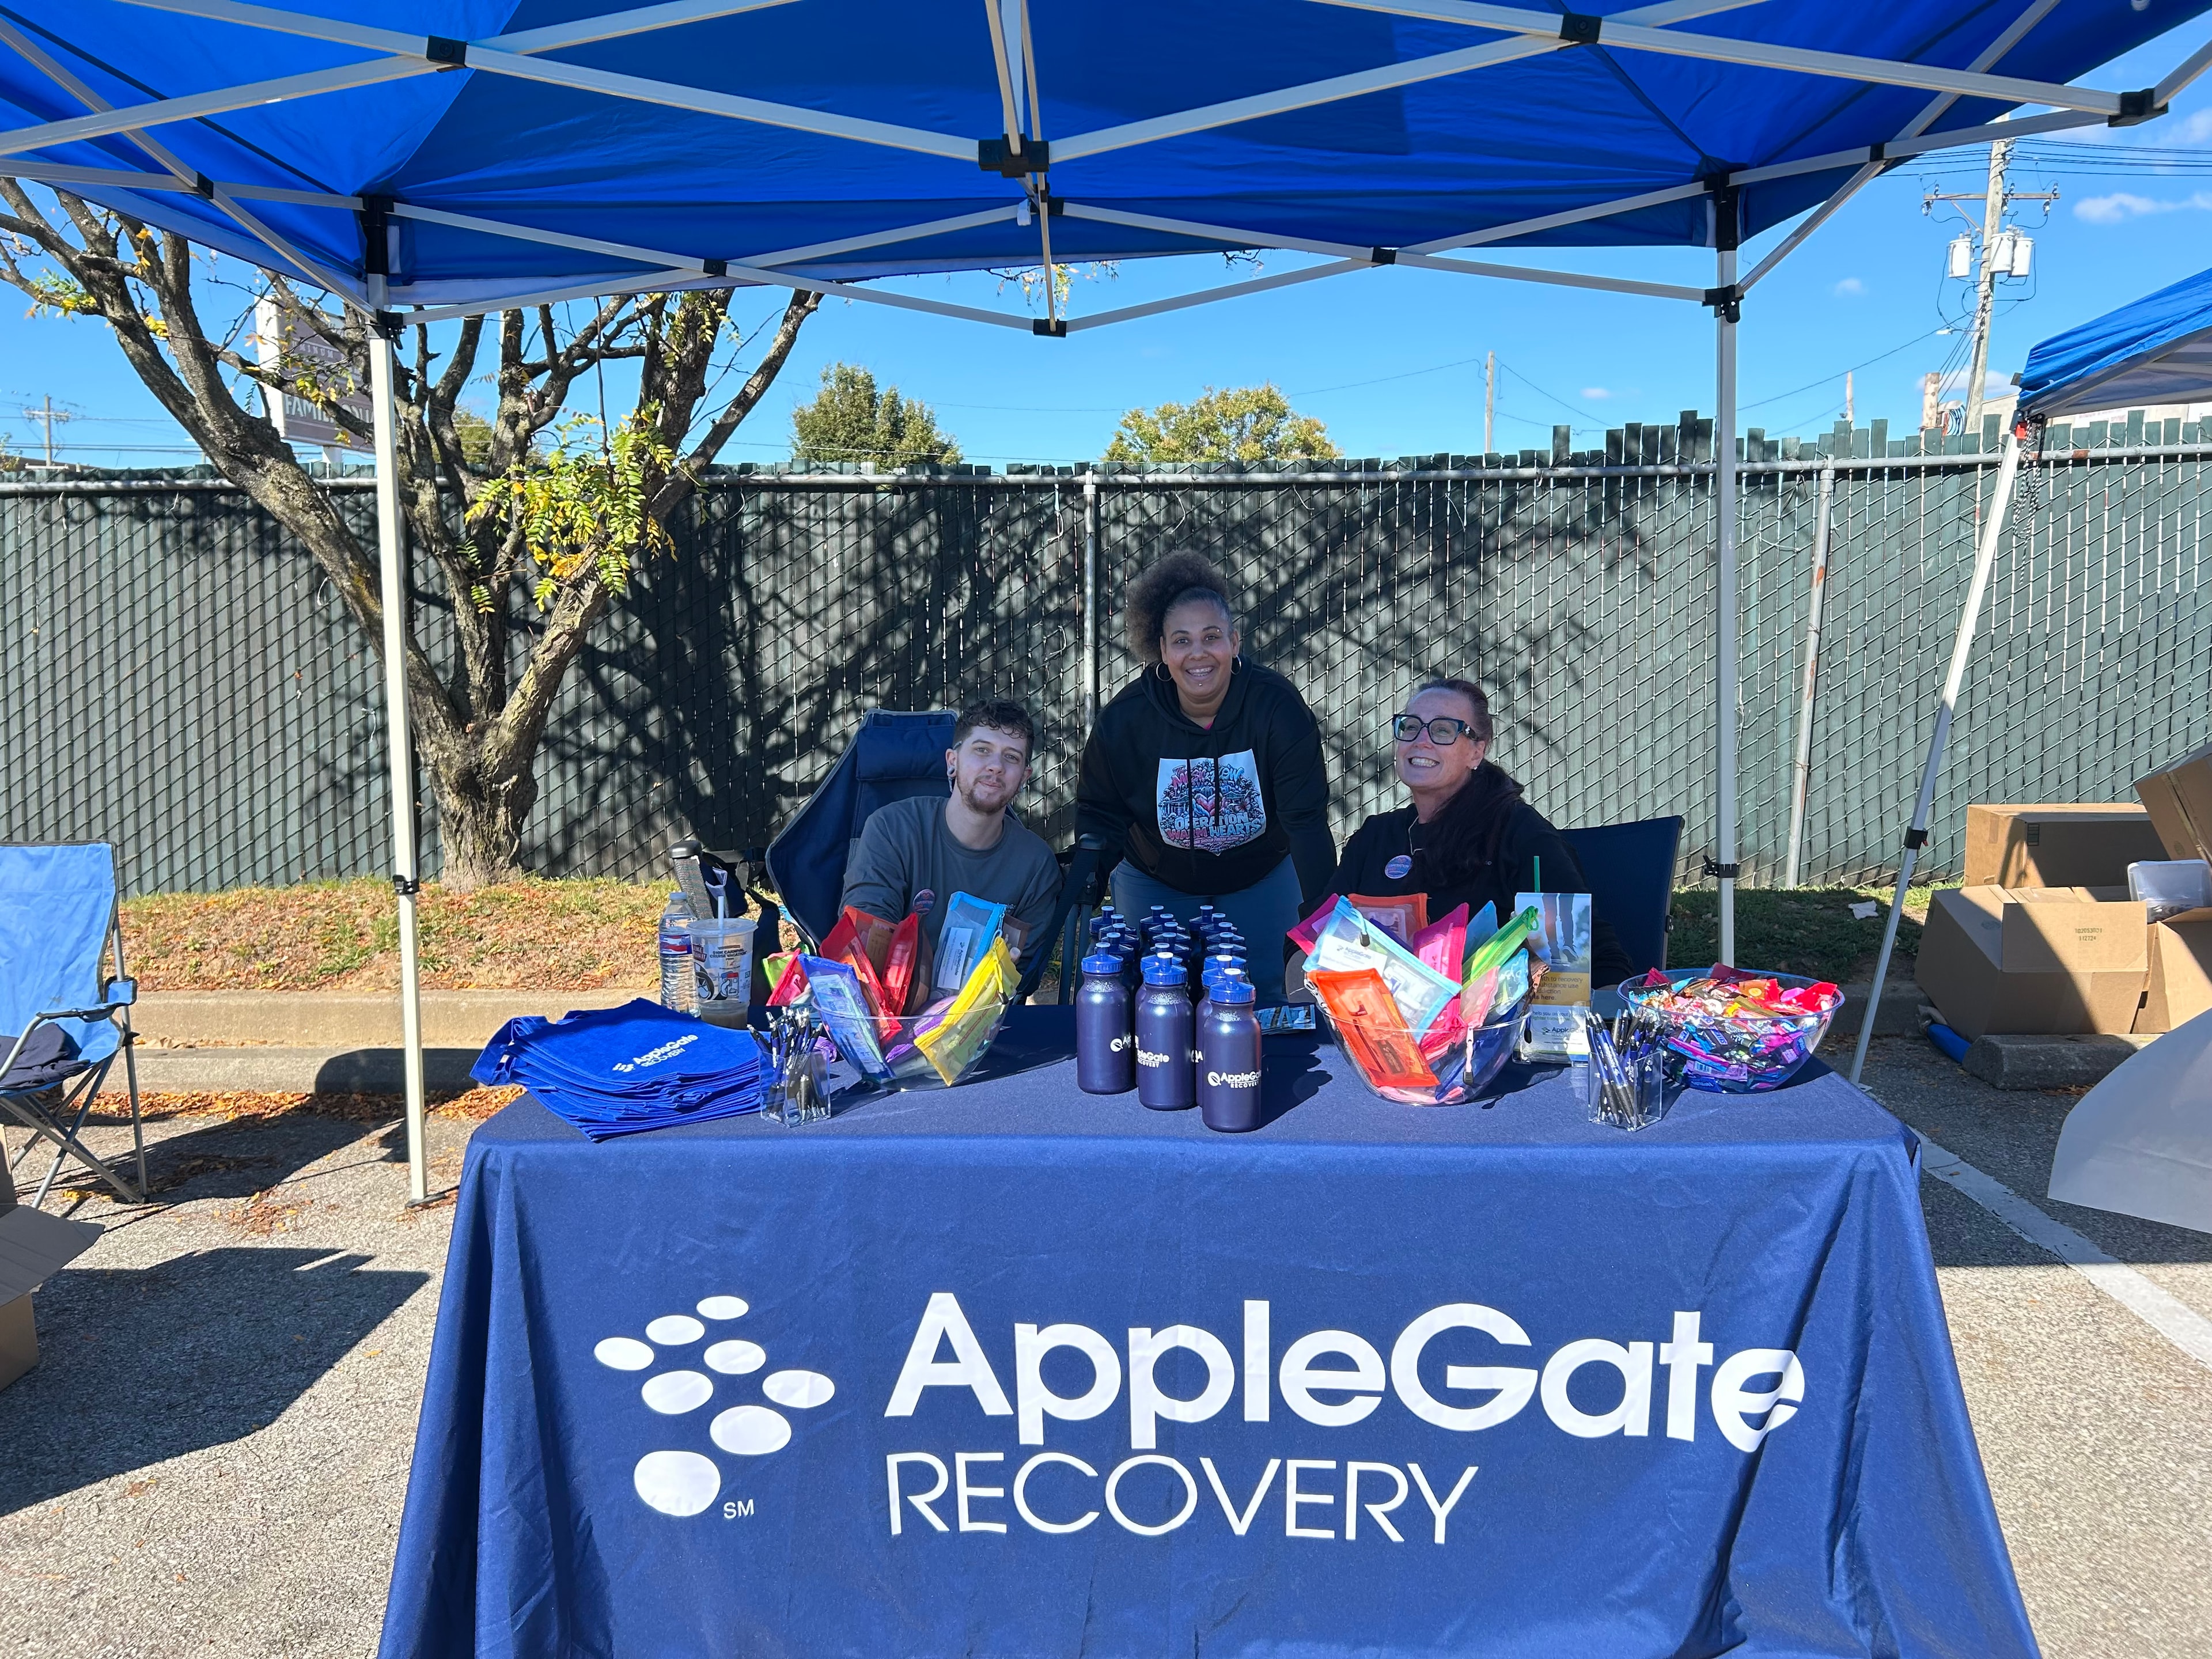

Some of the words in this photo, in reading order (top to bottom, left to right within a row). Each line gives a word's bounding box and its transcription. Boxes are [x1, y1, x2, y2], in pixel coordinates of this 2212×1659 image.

[1210, 818, 1262, 836] HEARTS
[633, 1035, 698, 1065] AppleGate
[641, 1047, 686, 1067] RECOVERY
[884, 1292, 1805, 1455] AppleGate
[723, 1498, 755, 1520] SM
[886, 1452, 1479, 1545] RECOVERY
